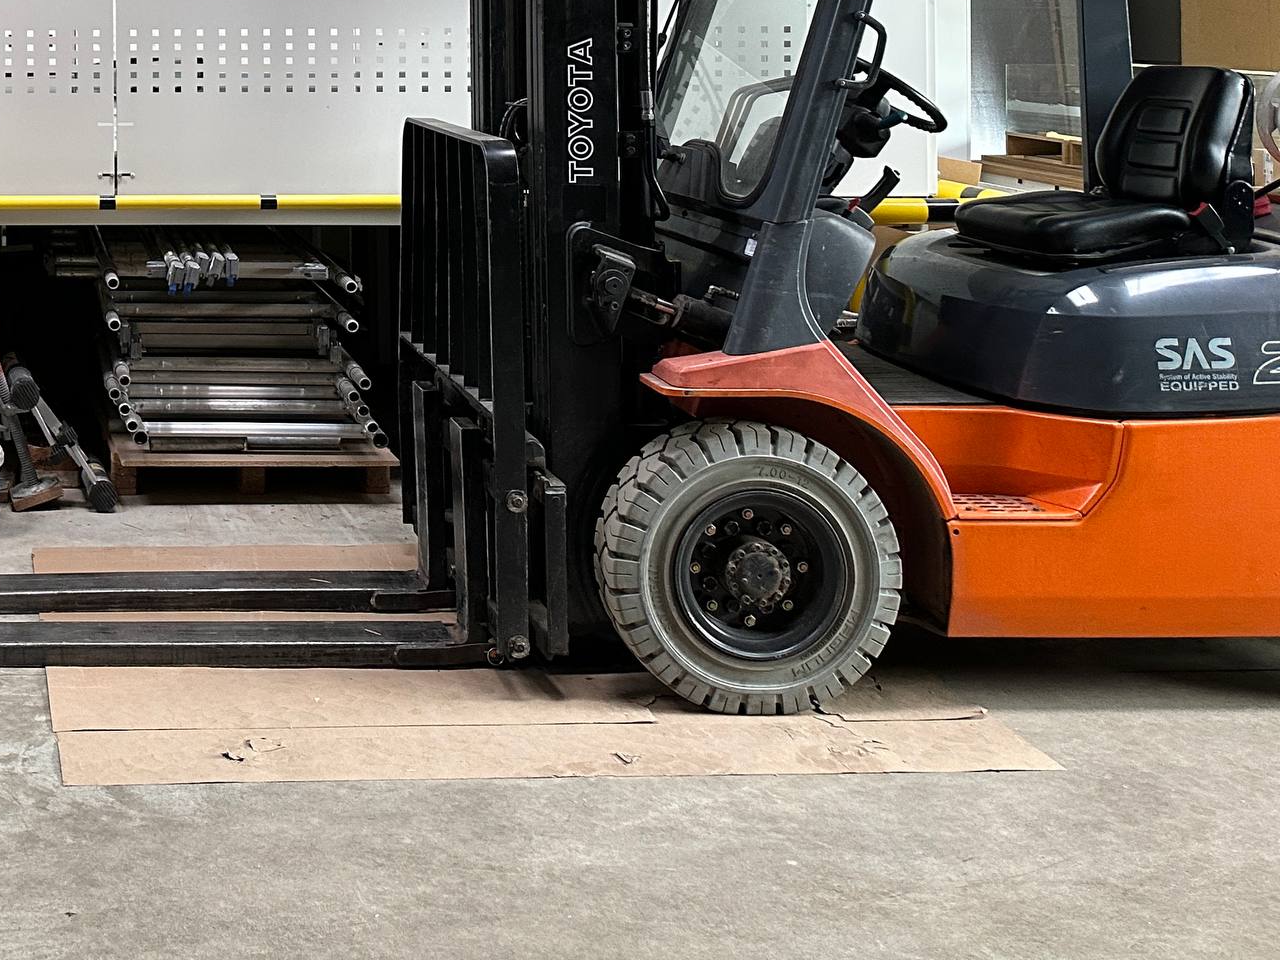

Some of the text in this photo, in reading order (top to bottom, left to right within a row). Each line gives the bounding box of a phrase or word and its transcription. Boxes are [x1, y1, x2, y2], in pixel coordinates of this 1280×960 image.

[567, 37, 594, 184] TOYOTA
[1155, 338, 1236, 370] SAS
[1160, 381, 1240, 391] EQUIPPED
[1212, 373, 1238, 381] Stability
